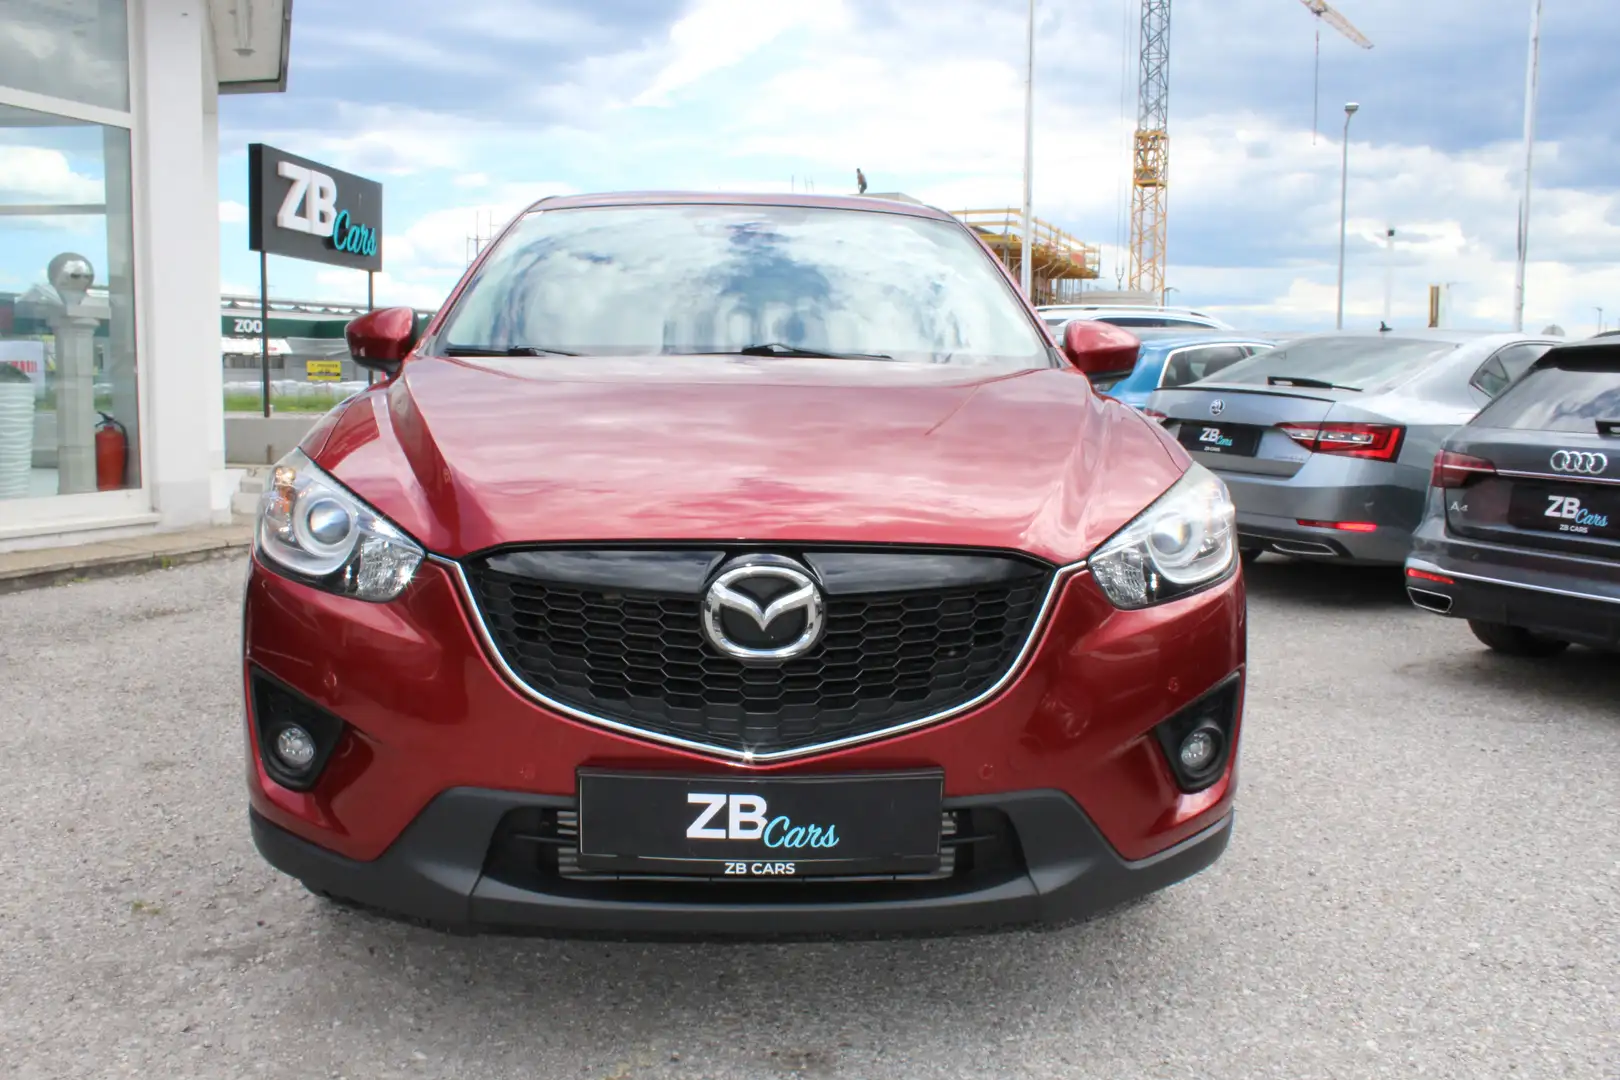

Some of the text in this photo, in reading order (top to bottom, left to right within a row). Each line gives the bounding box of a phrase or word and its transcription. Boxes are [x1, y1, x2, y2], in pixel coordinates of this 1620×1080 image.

[277, 161, 377, 256] ZB Cars
[234, 319, 263, 333] ZOO
[1199, 427, 1219, 442] ZB
[1544, 495, 1608, 527] ZB Cars
[686, 793, 840, 848] ZB Cars
[724, 862, 795, 875] ZB CARS
